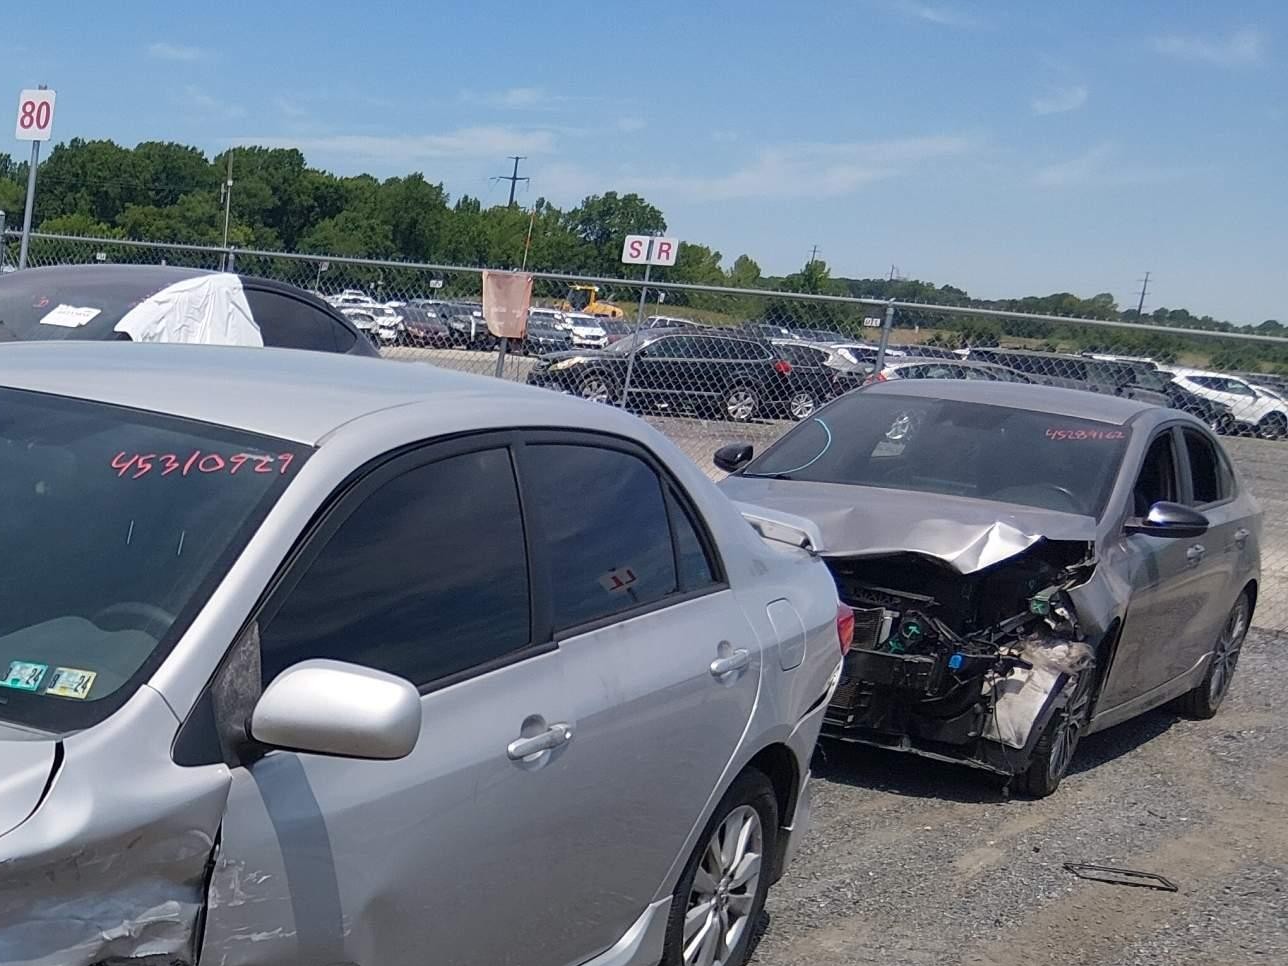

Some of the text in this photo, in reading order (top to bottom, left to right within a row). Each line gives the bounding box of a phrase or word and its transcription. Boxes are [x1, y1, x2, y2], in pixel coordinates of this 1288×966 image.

[20, 100, 50, 129] 80
[629, 240, 672, 260] S R
[111, 450, 294, 479] 45310929
